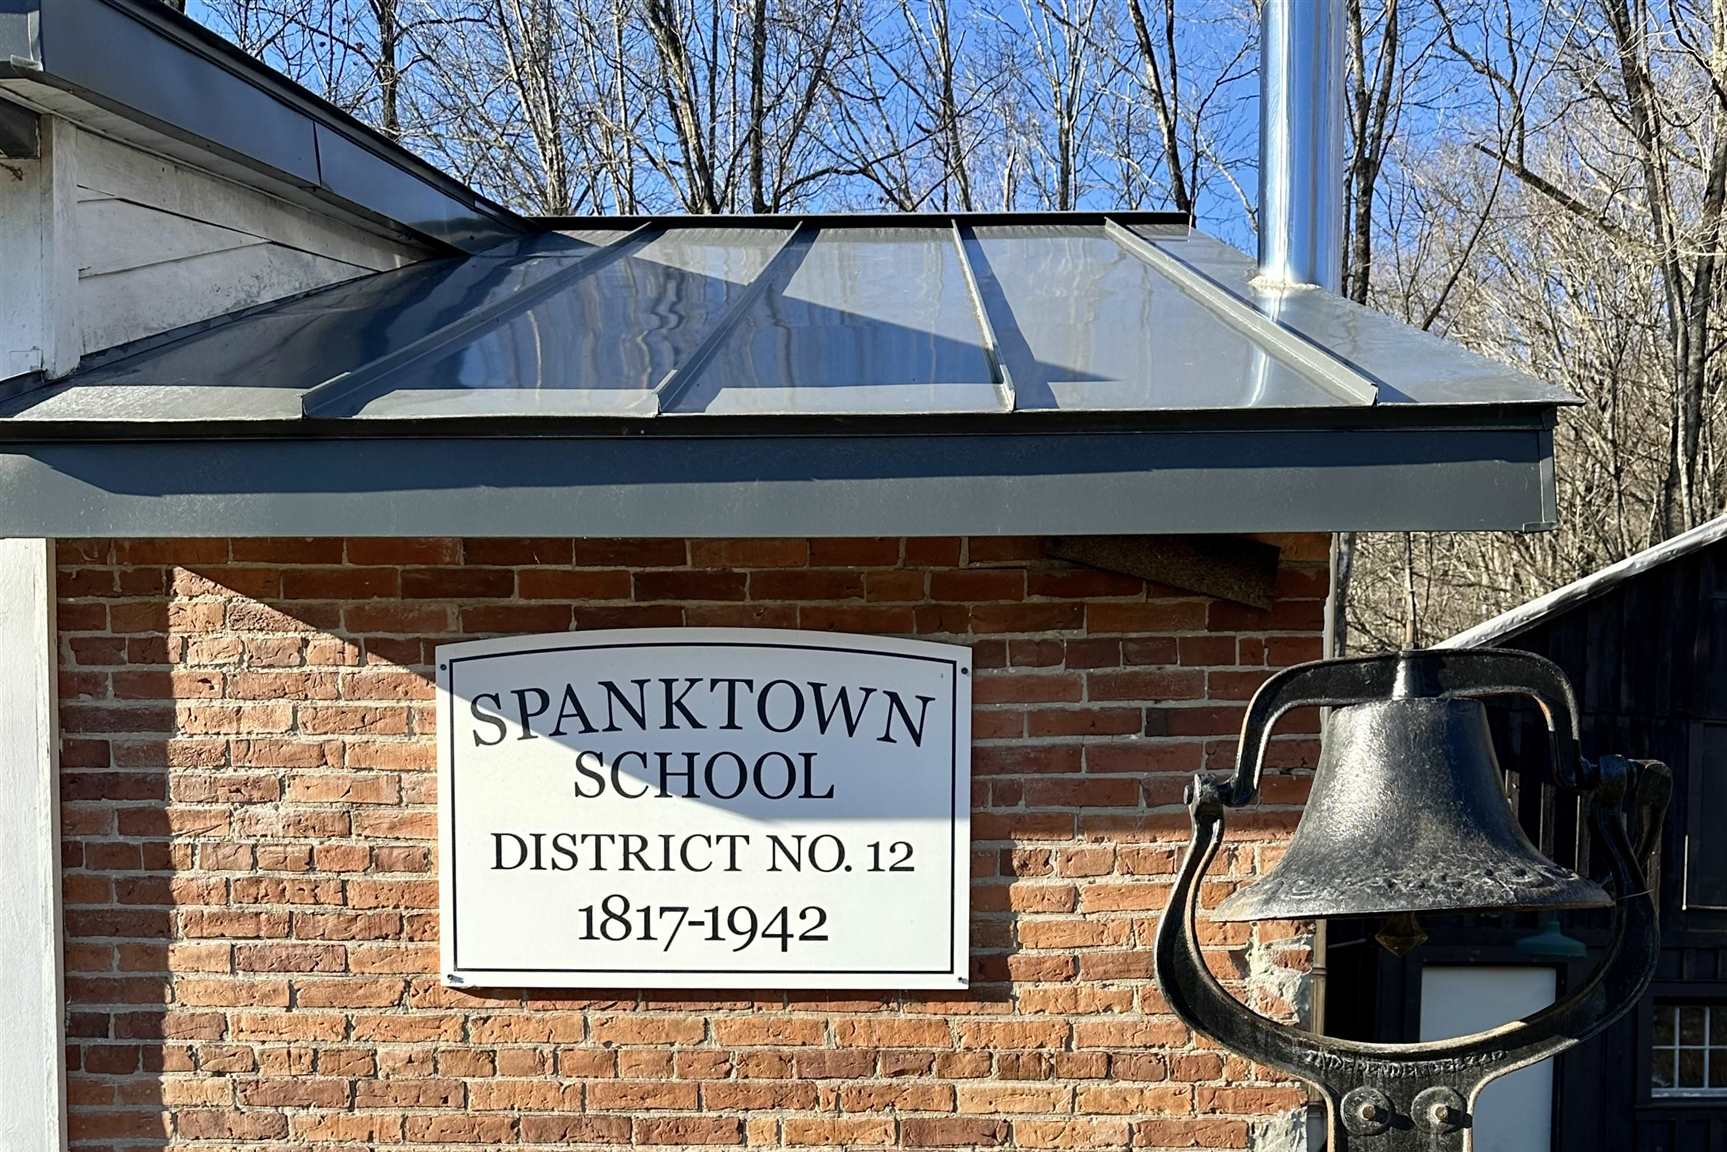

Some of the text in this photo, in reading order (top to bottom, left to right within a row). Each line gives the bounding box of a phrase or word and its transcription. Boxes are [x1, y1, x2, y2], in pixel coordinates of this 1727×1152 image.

[470, 677, 936, 748] SPANKTOWN
[573, 750, 835, 800] SCHOOL
[490, 832, 915, 873] DISTRICT NO. 12
[577, 894, 829, 953] 1817-1942
